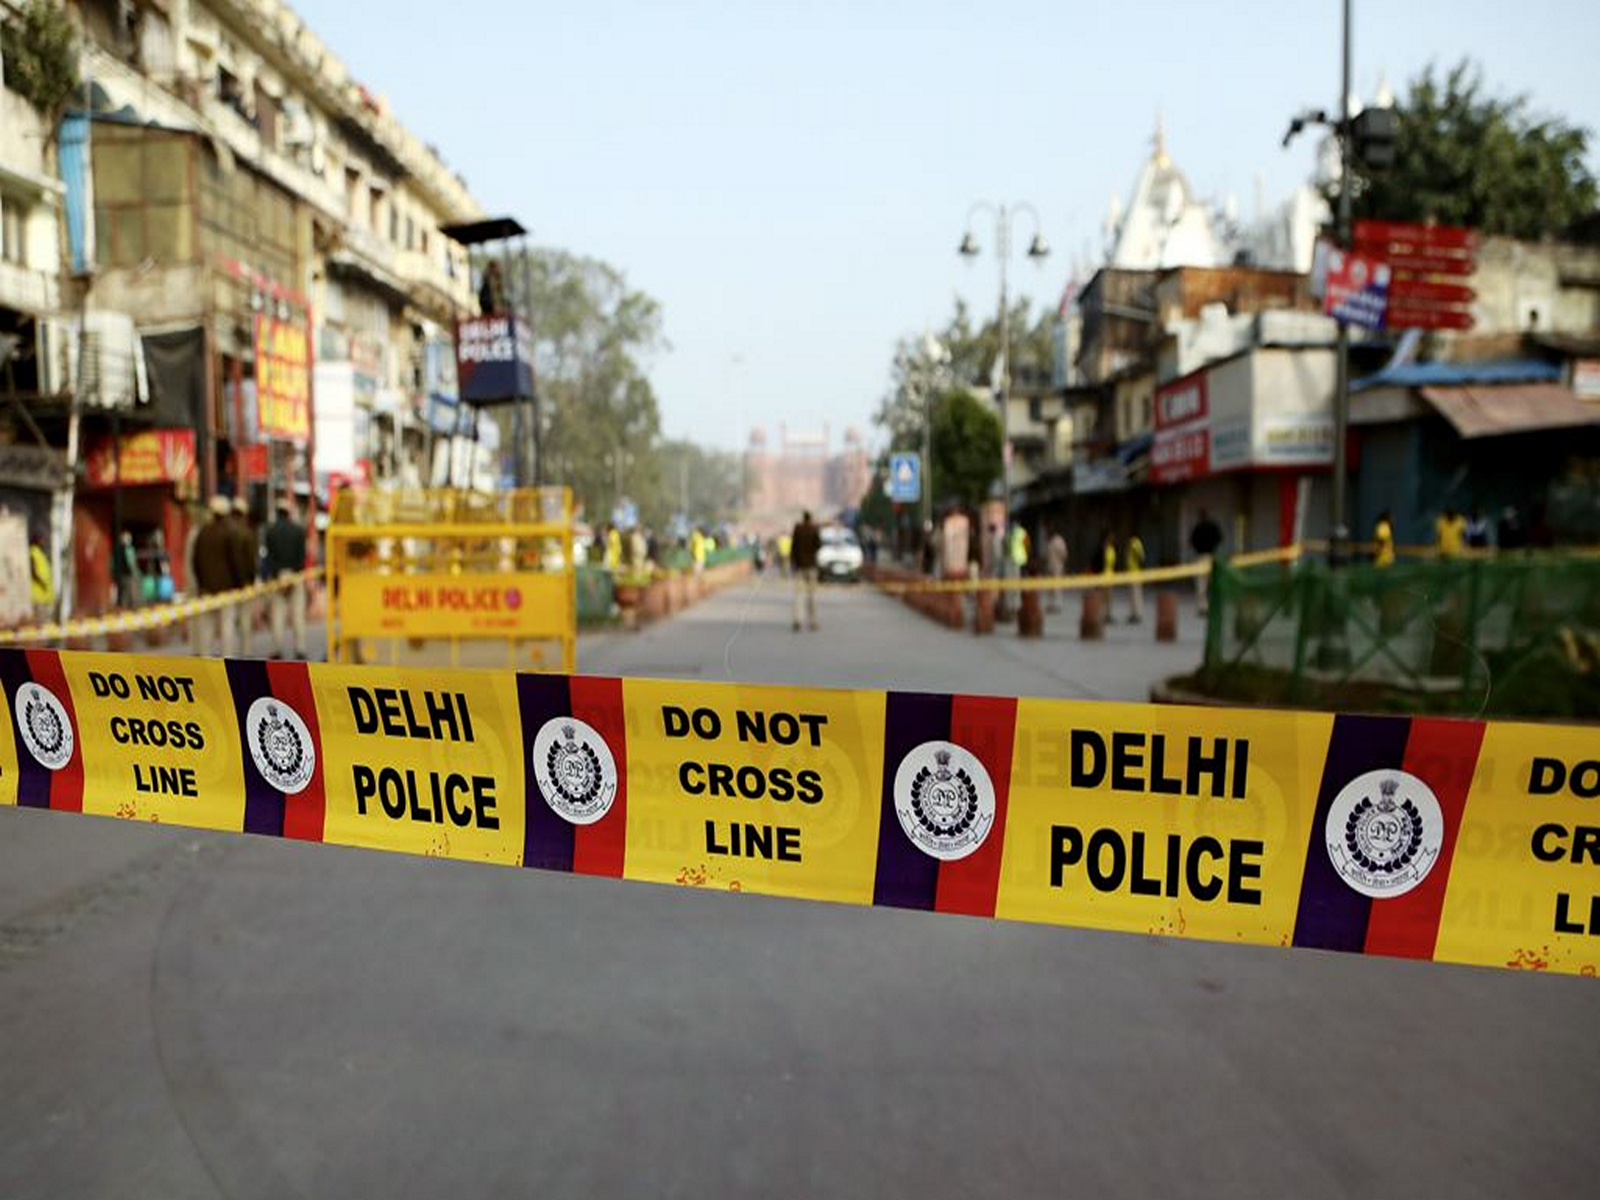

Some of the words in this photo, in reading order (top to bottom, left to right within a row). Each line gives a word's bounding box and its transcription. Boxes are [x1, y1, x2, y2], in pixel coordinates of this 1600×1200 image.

[381, 585, 433, 611] DELHI
[437, 585, 500, 612] POLICE
[88, 672, 130, 699] DO
[135, 675, 194, 703] NOT
[110, 716, 205, 750] CROSS
[347, 686, 474, 742] DELHI
[662, 706, 722, 740] DO
[736, 710, 828, 747] NOT
[133, 764, 198, 797] LINE
[679, 761, 824, 804] CROSS
[1070, 729, 1250, 799] DELHI
[1528, 757, 1600, 798] DO
[352, 765, 500, 830] POLICE
[705, 820, 802, 862] LINE
[1050, 825, 1264, 905] POLICE
